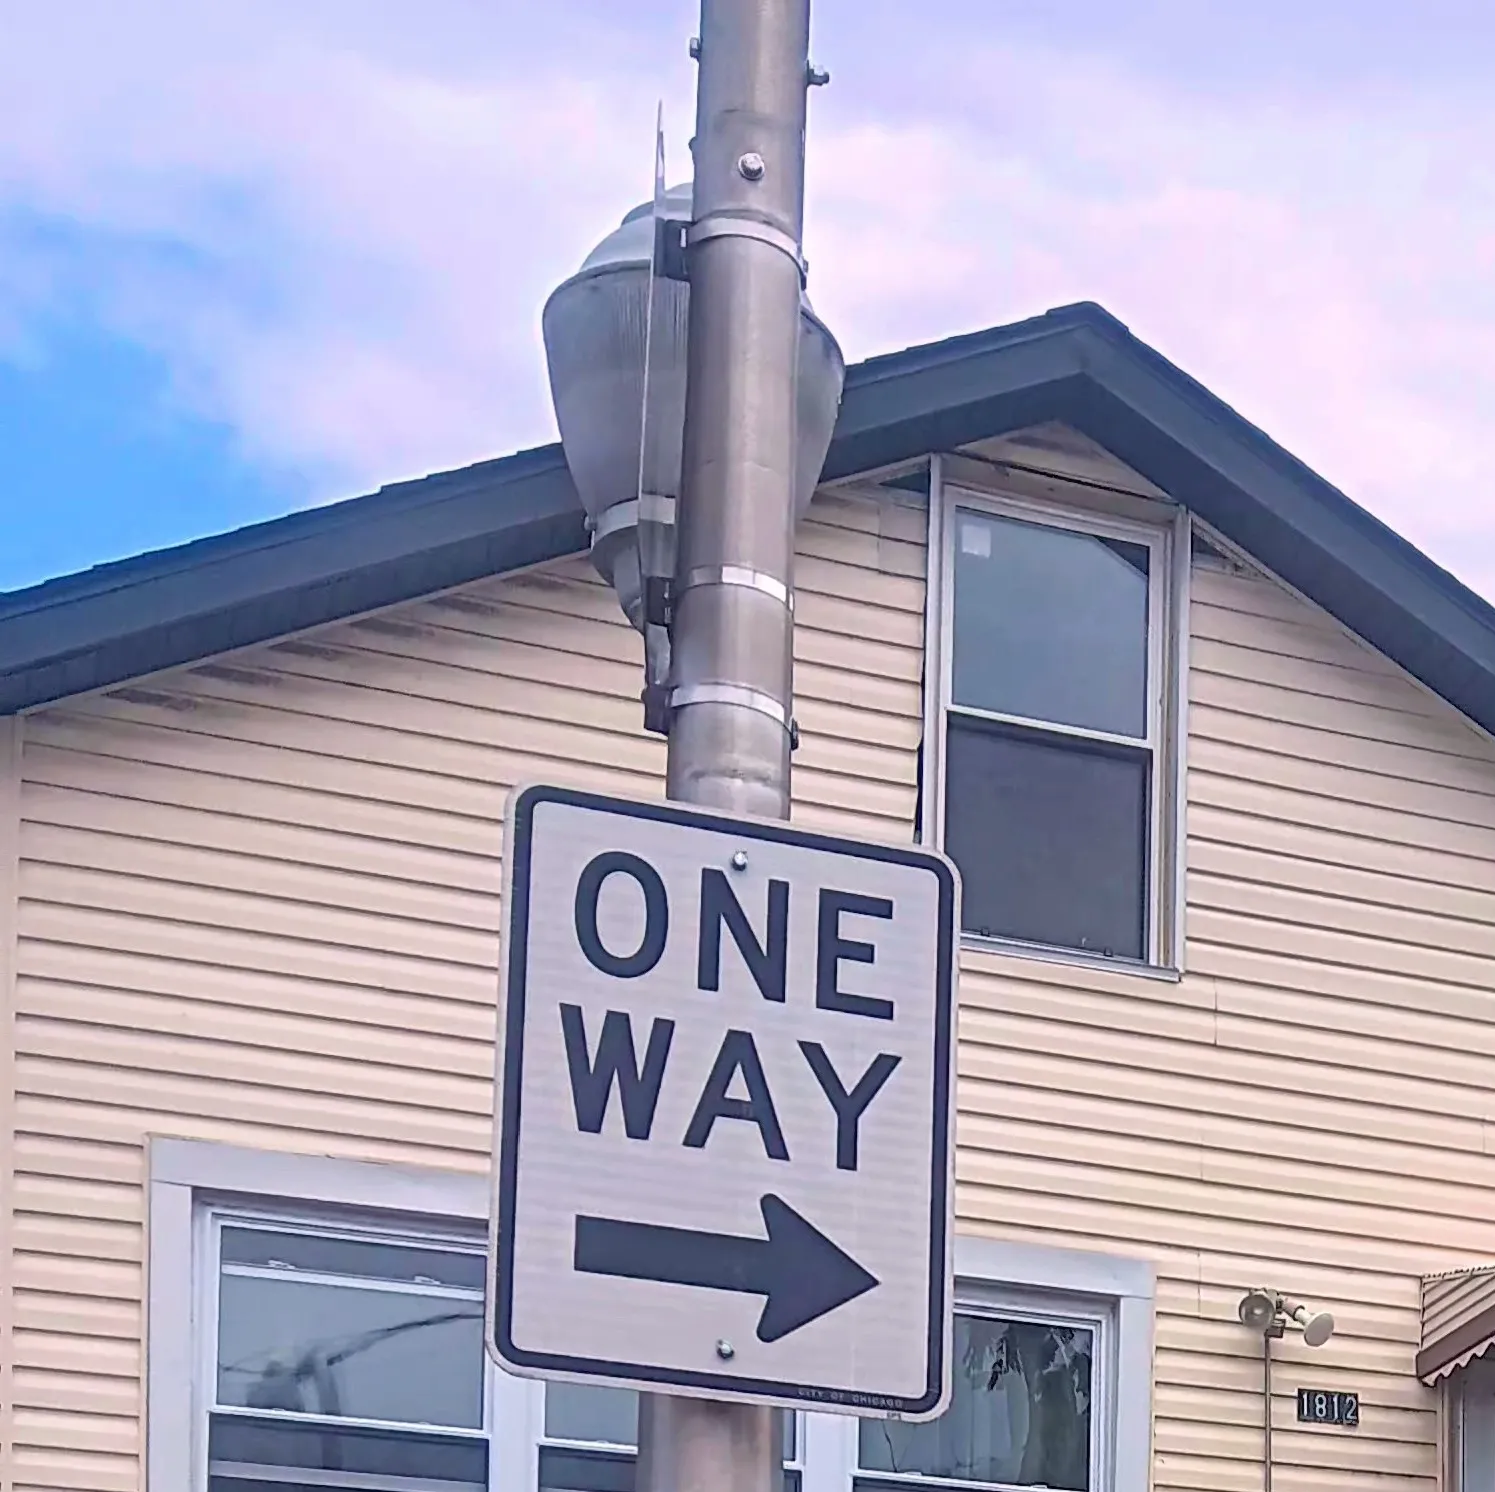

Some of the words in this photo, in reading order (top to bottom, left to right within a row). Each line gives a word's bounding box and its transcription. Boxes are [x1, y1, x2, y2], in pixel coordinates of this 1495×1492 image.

[574, 850, 895, 1020] ONE
[558, 1002, 902, 1172] WAY
[797, 1387, 824, 1399] CITY
[852, 1393, 903, 1409] CHICAGO
[1302, 1391, 1358, 1420] 1812
